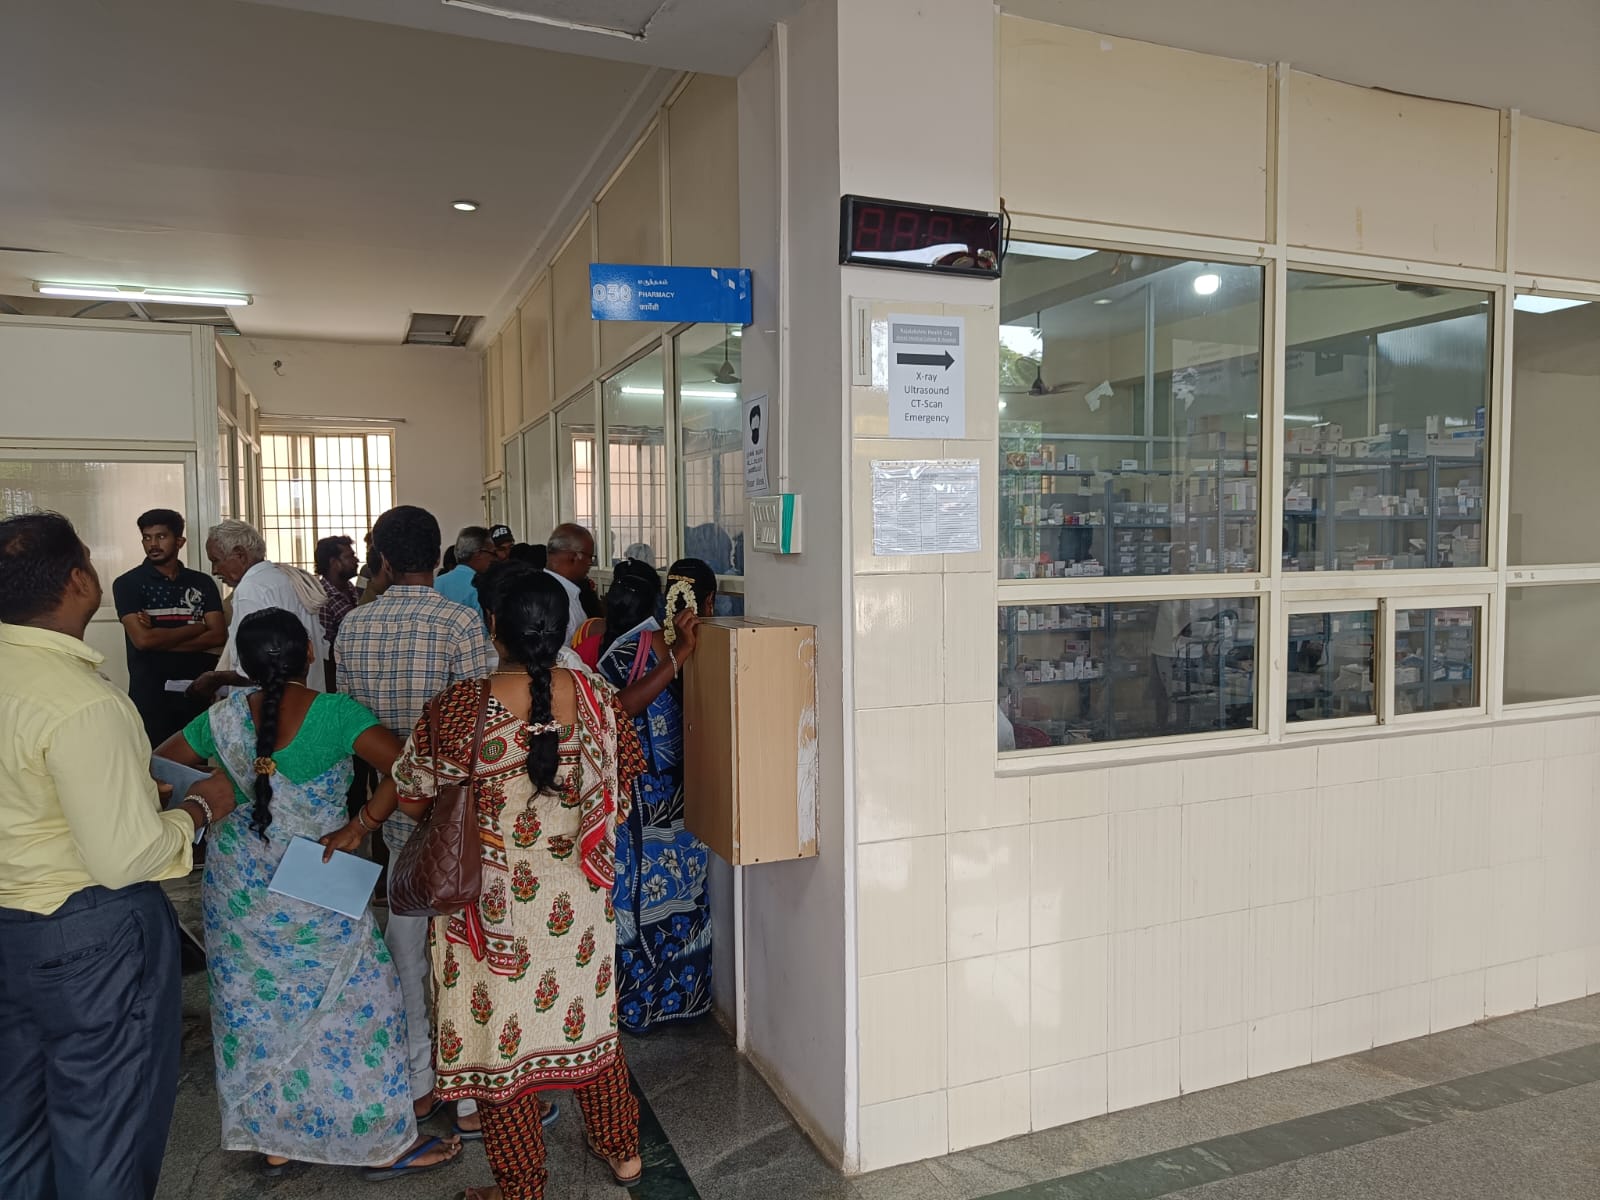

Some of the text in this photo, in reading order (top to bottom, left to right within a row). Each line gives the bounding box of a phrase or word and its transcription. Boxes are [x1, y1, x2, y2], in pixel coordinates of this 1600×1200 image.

[916, 371, 938, 382] X-ray
[904, 385, 950, 395] Ultrasound
[911, 399, 943, 408] CT-Scan
[904, 412, 950, 424] Emergency
